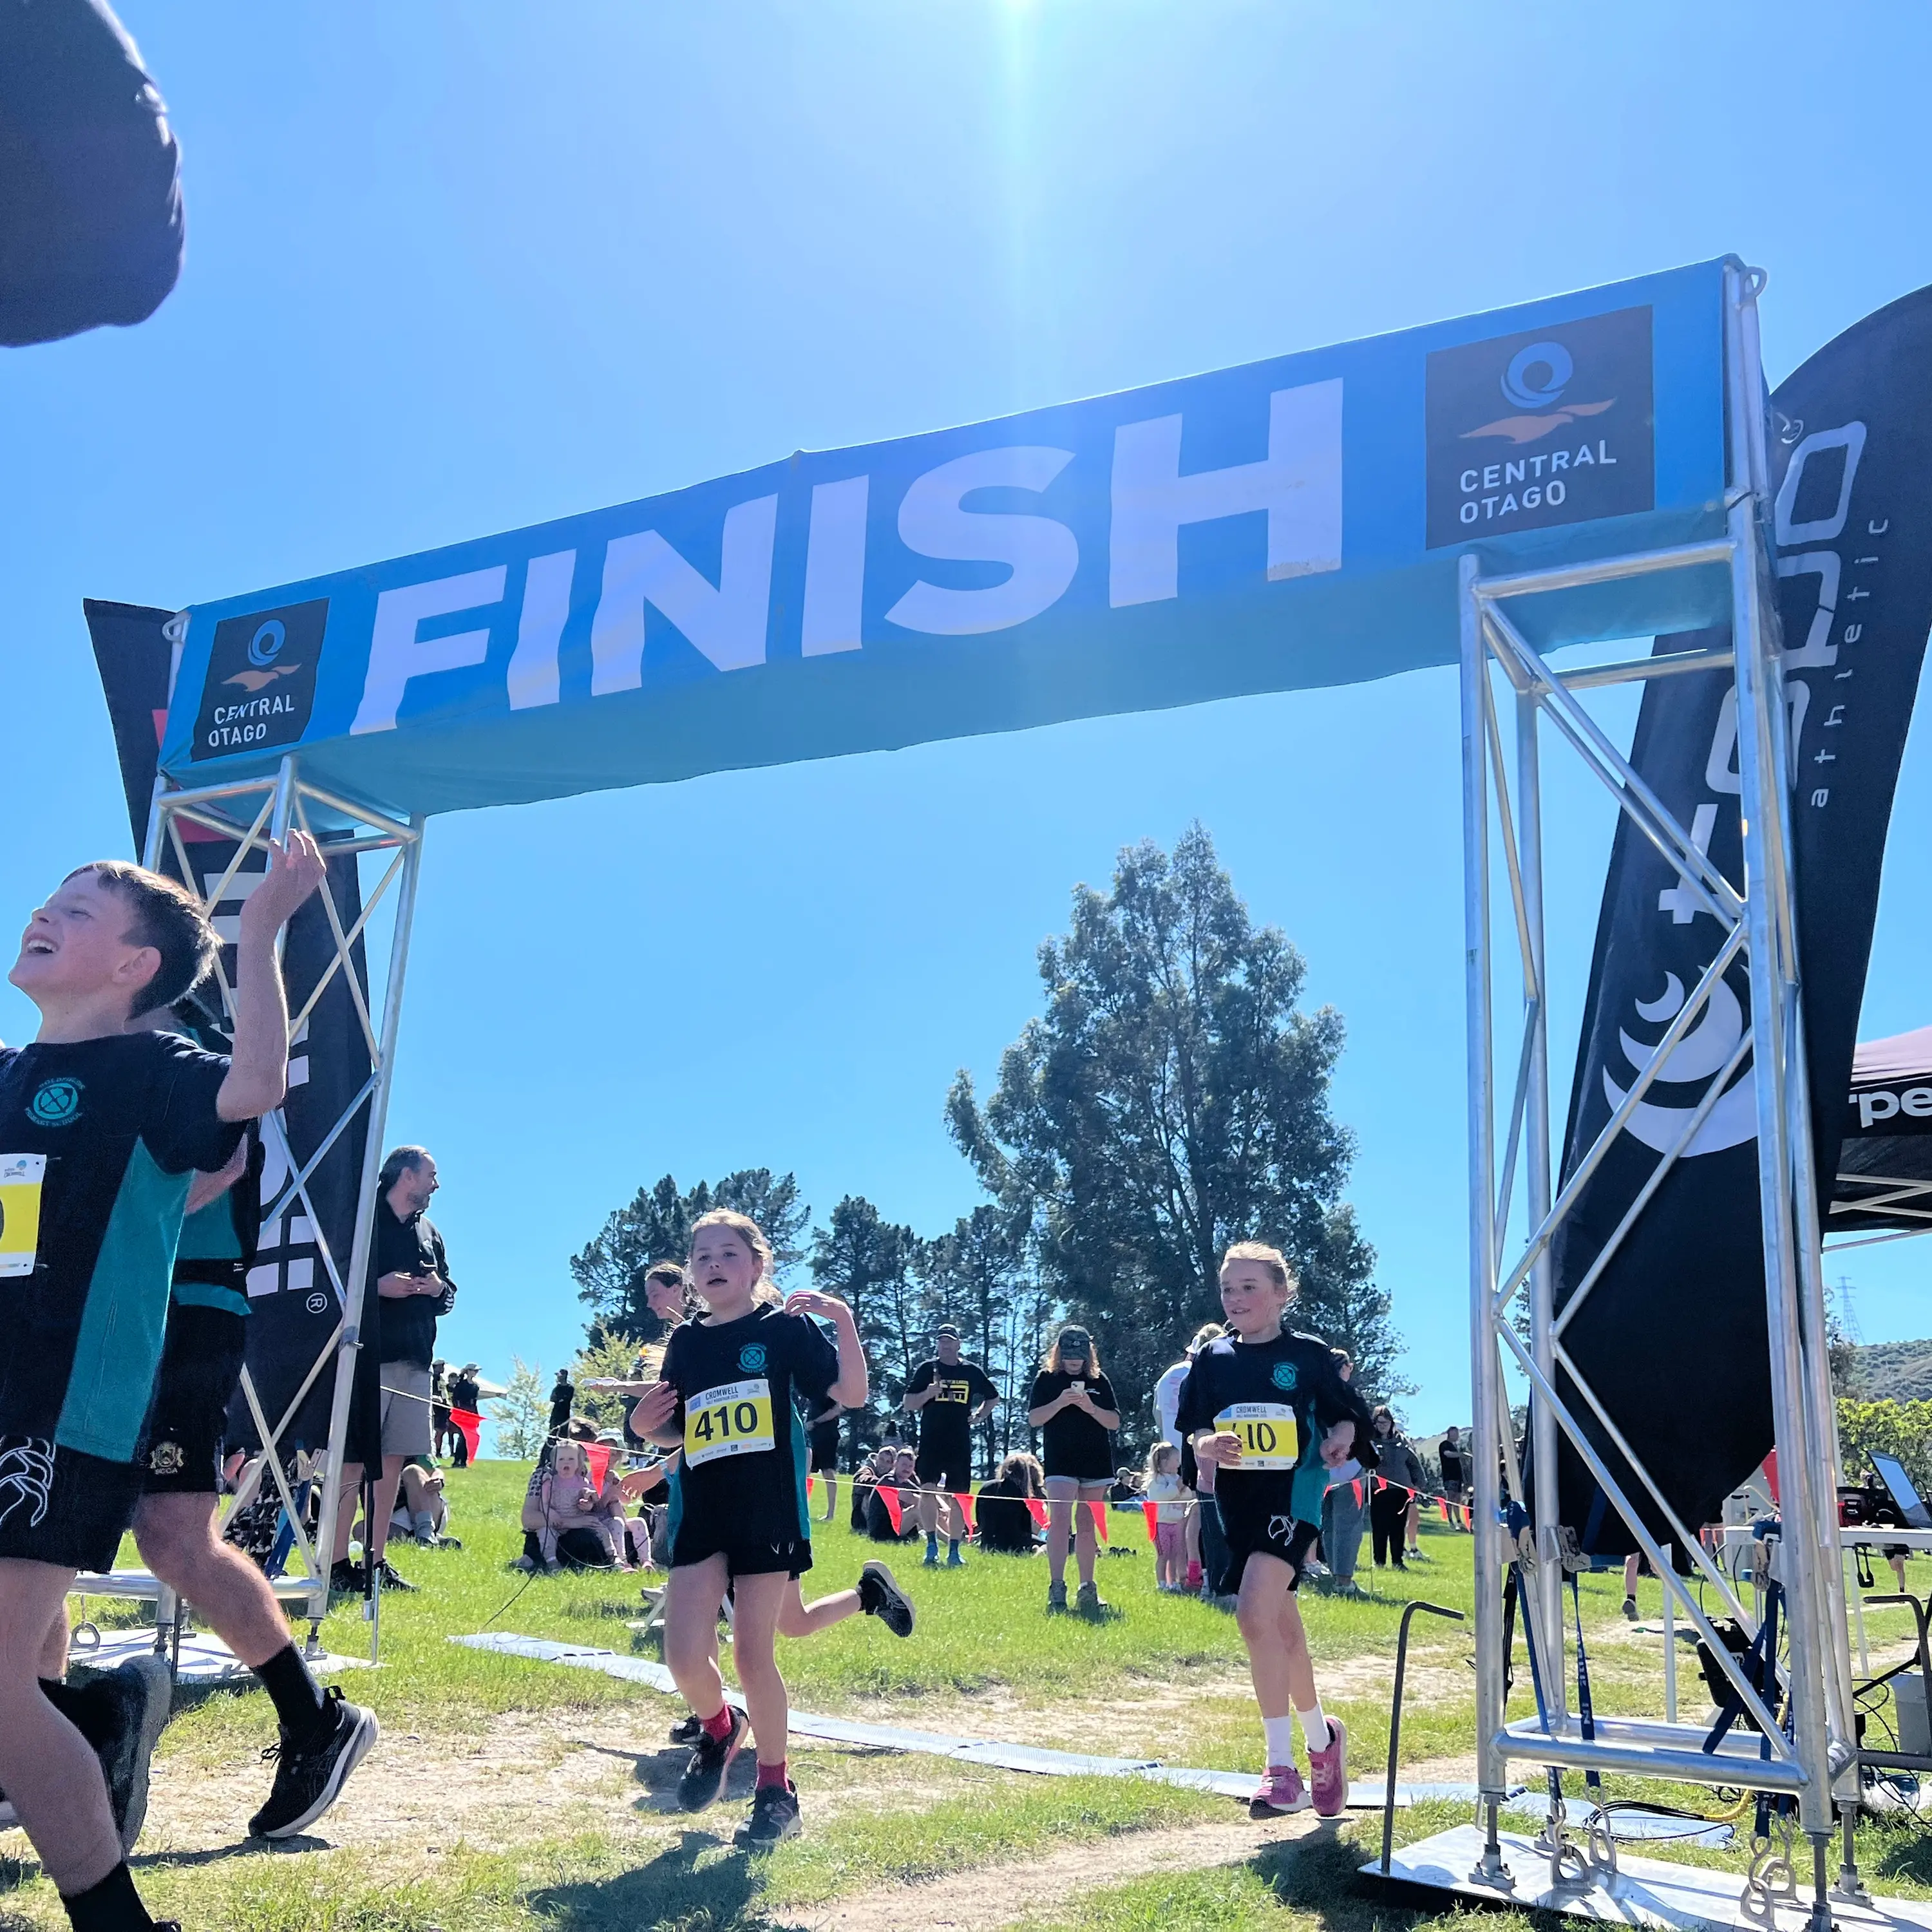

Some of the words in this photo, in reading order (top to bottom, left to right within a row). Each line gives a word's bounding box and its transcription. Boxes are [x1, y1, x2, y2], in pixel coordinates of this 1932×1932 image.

[1459, 439, 1617, 493] CENTRAL
[1459, 480, 1566, 524] OTAGO
[349, 377, 1344, 735] FINISH
[1811, 518, 1889, 808] athletic
[214, 694, 295, 725] CENTRAL
[208, 723, 267, 747] OTAGO
[705, 1386, 739, 1401] CROMWELL
[694, 1401, 758, 1441] 410
